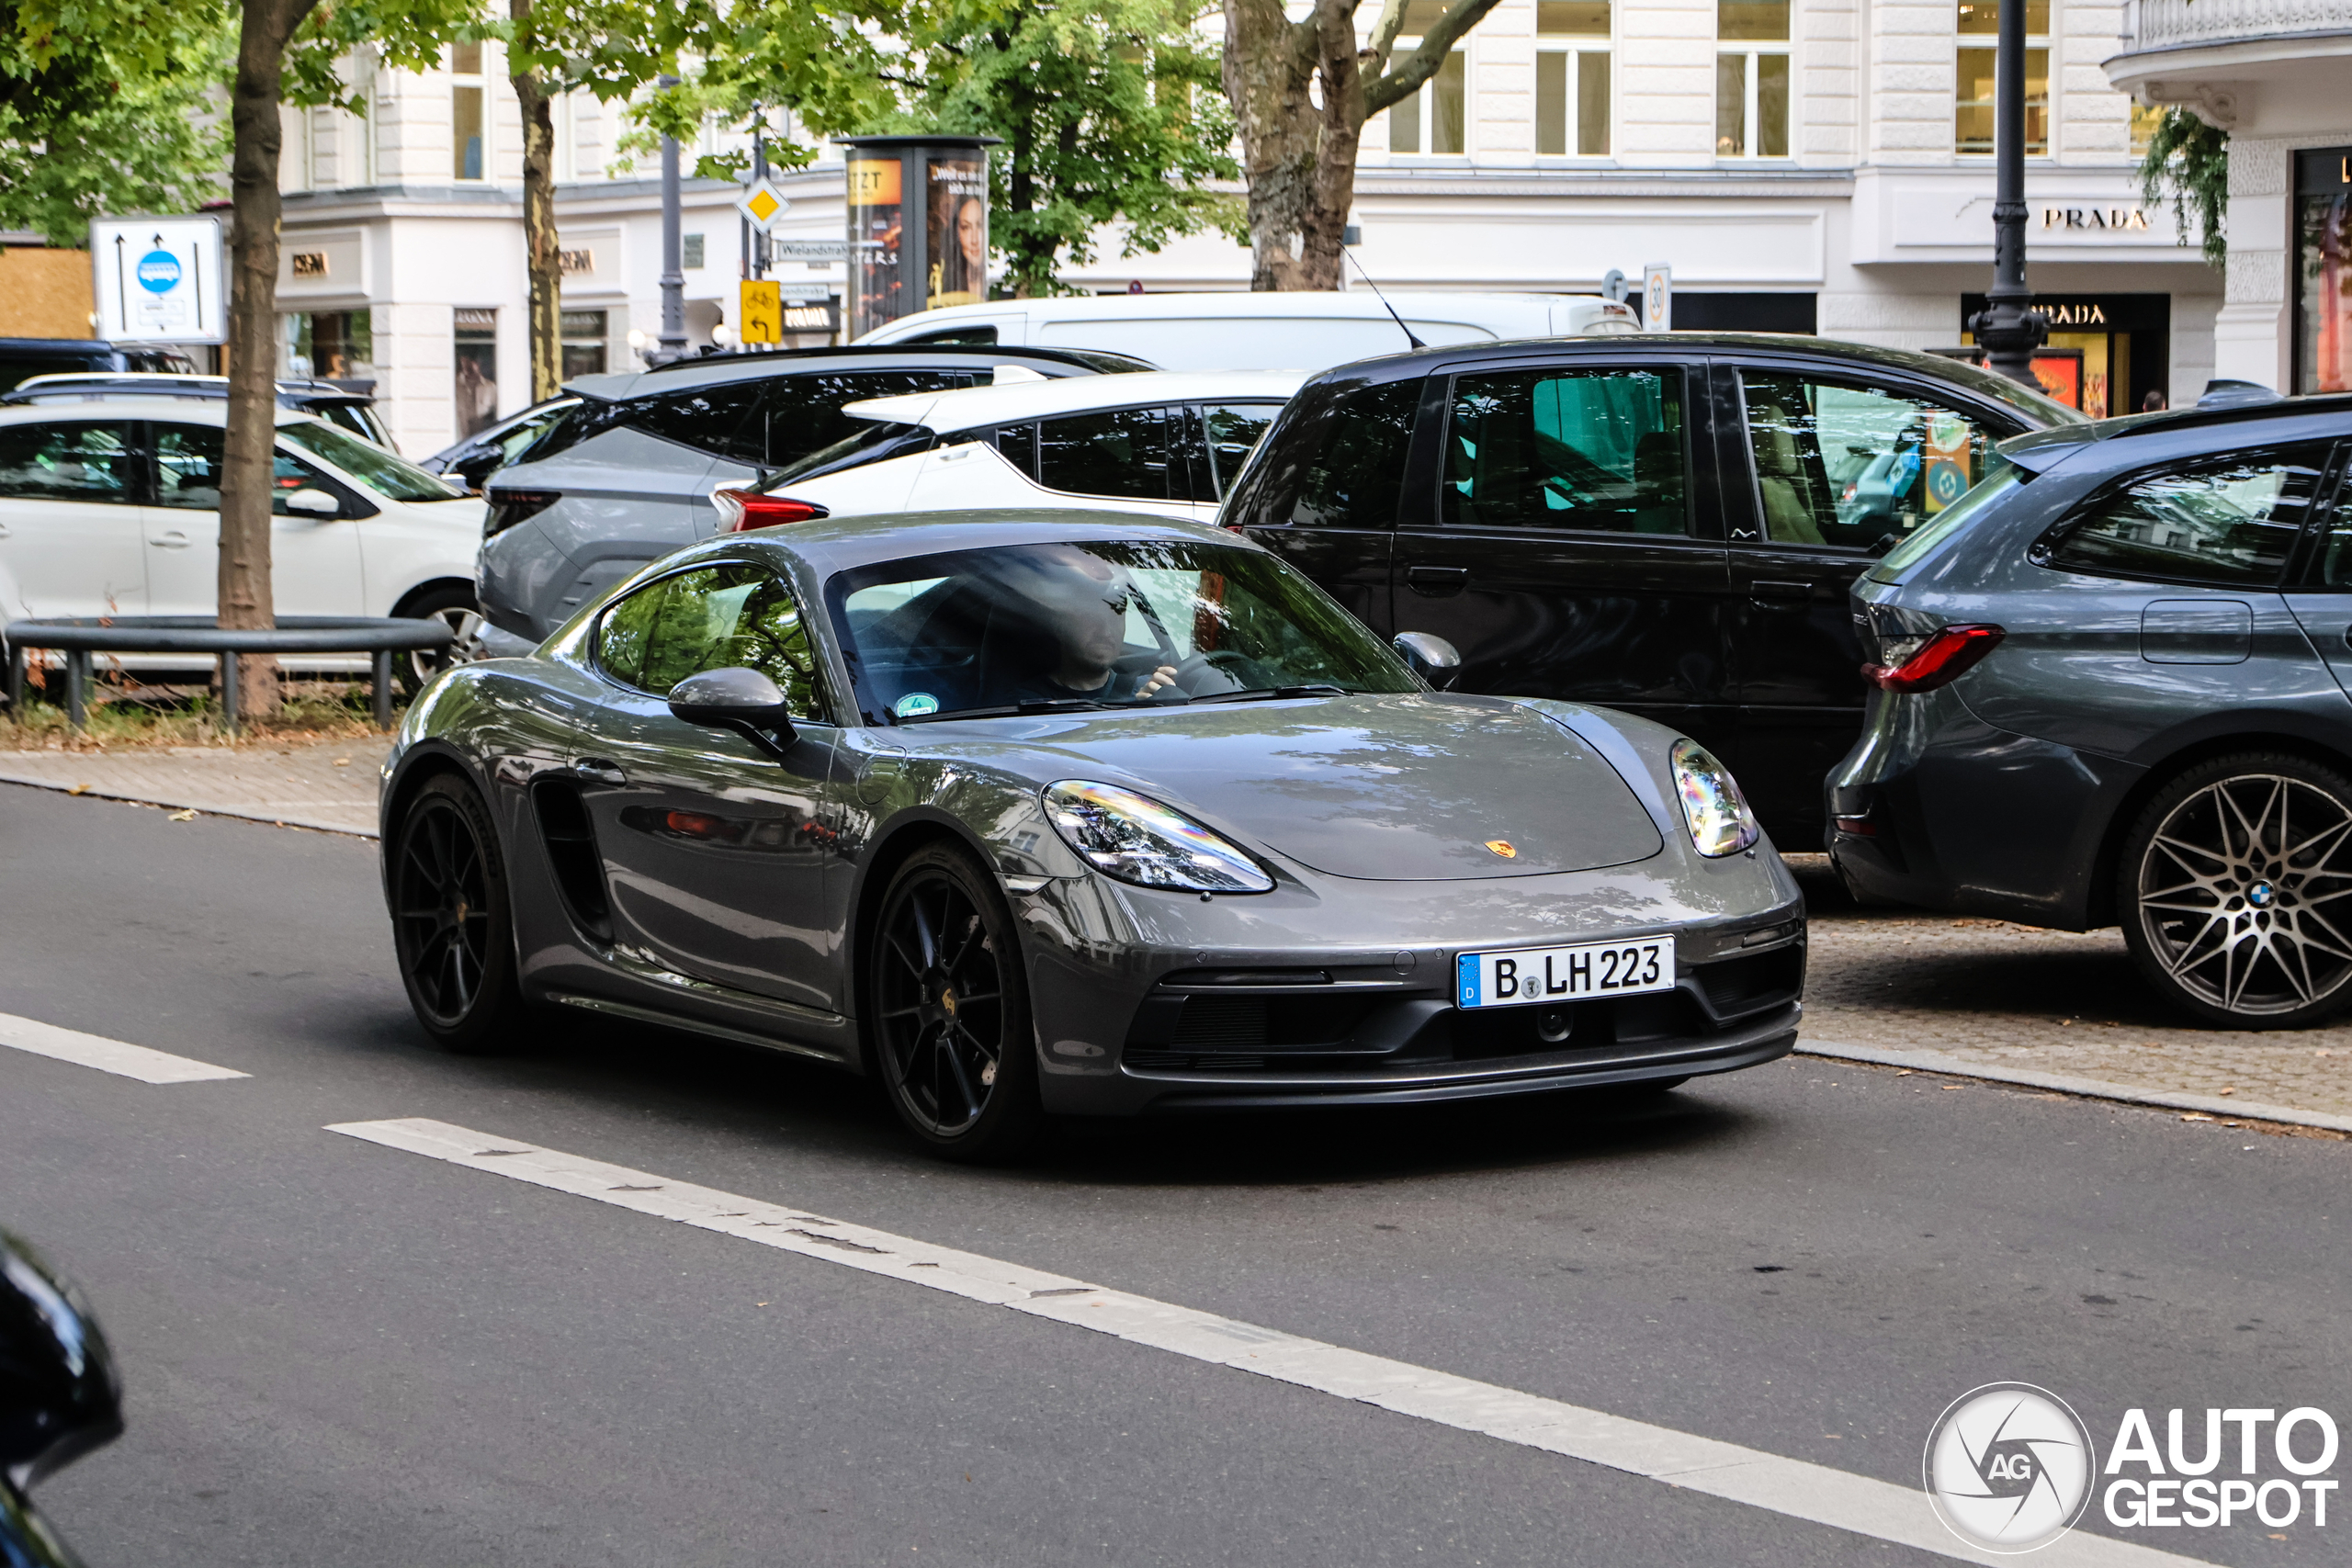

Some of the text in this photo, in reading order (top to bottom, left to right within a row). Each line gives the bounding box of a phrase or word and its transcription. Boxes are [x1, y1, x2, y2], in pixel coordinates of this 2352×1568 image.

[2043, 209, 2148, 230] PRADA
[1652, 286, 1662, 309] 30
[910, 697, 922, 708] 4
[1496, 958, 1519, 998] B
[1545, 952, 1591, 995] LH
[1600, 944, 1660, 988] 223
[1465, 987, 1475, 1000] D
